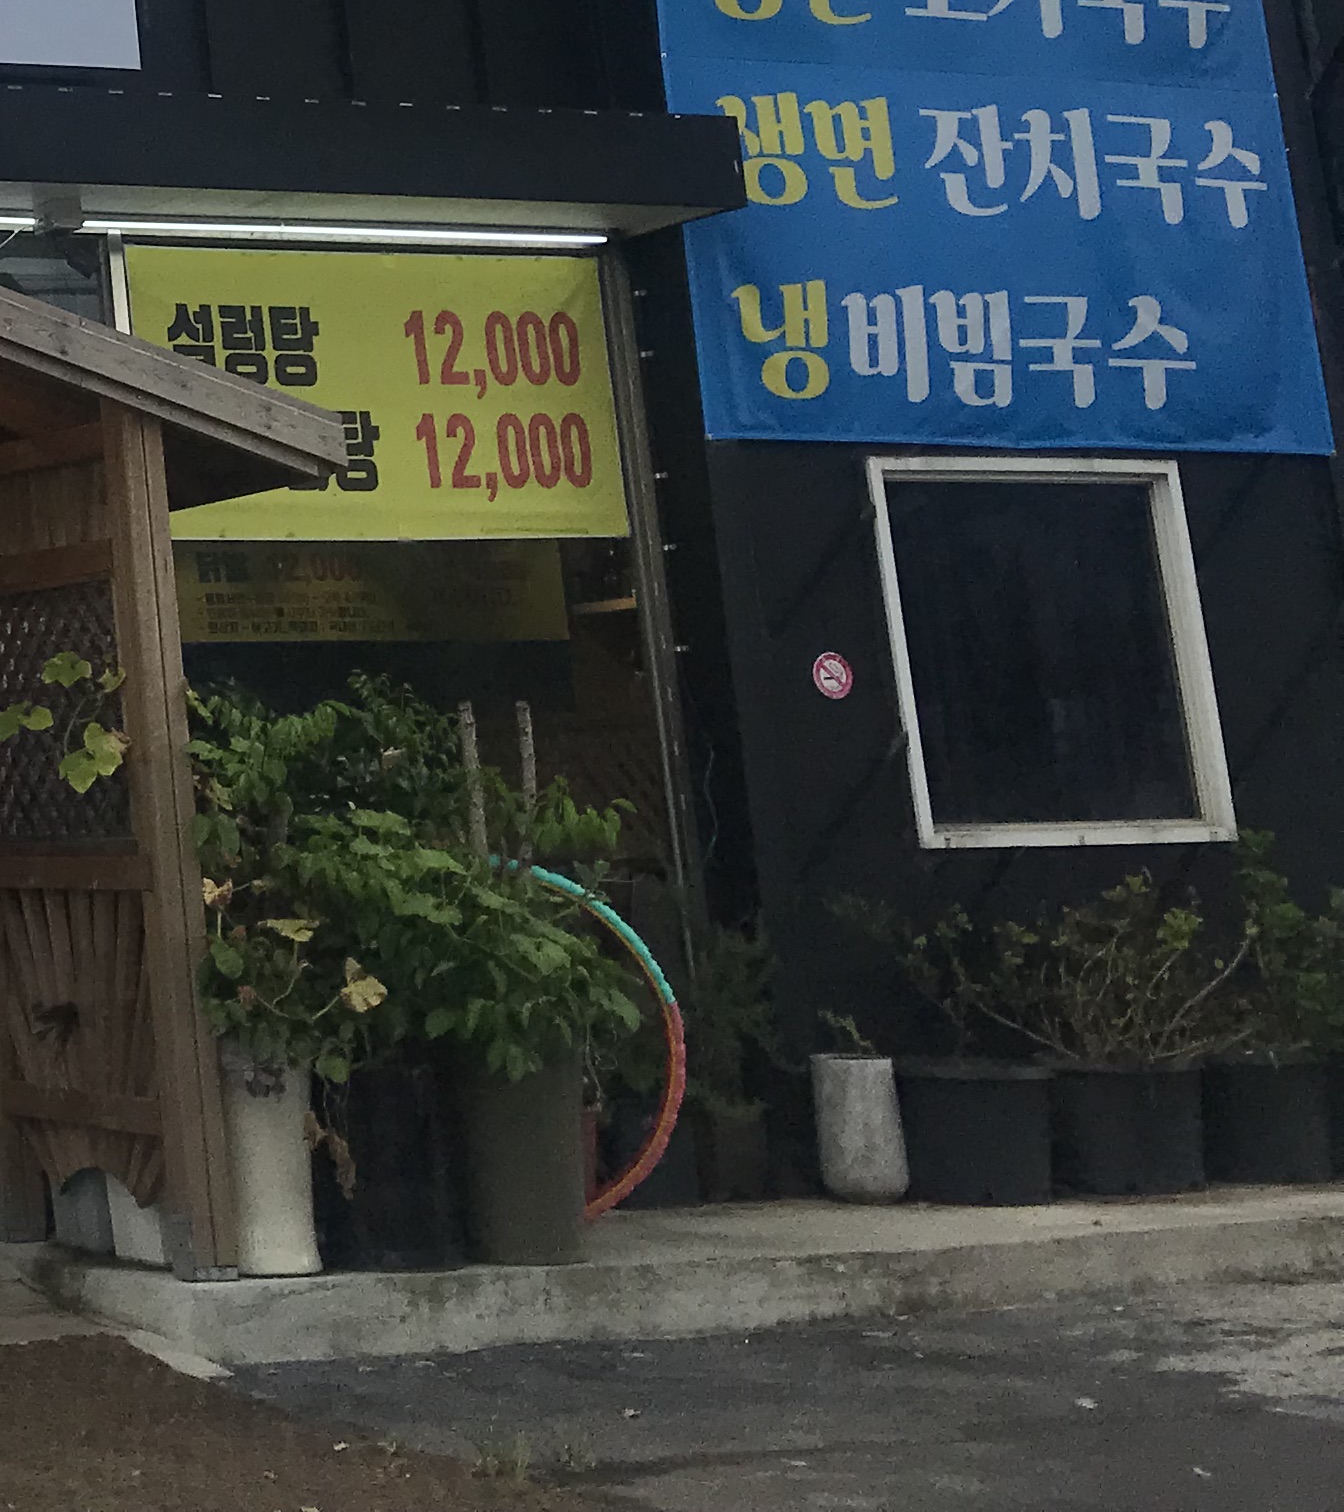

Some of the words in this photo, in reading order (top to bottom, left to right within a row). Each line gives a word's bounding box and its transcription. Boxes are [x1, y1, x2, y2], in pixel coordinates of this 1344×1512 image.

[716, 91, 900, 210] 생면
[918, 104, 1268, 229] 잔치국수
[167, 302, 320, 387] 설렁탕
[404, 311, 580, 399] 12,000
[731, 279, 1197, 410] 냉비빔국수
[415, 413, 592, 502] 12,000
